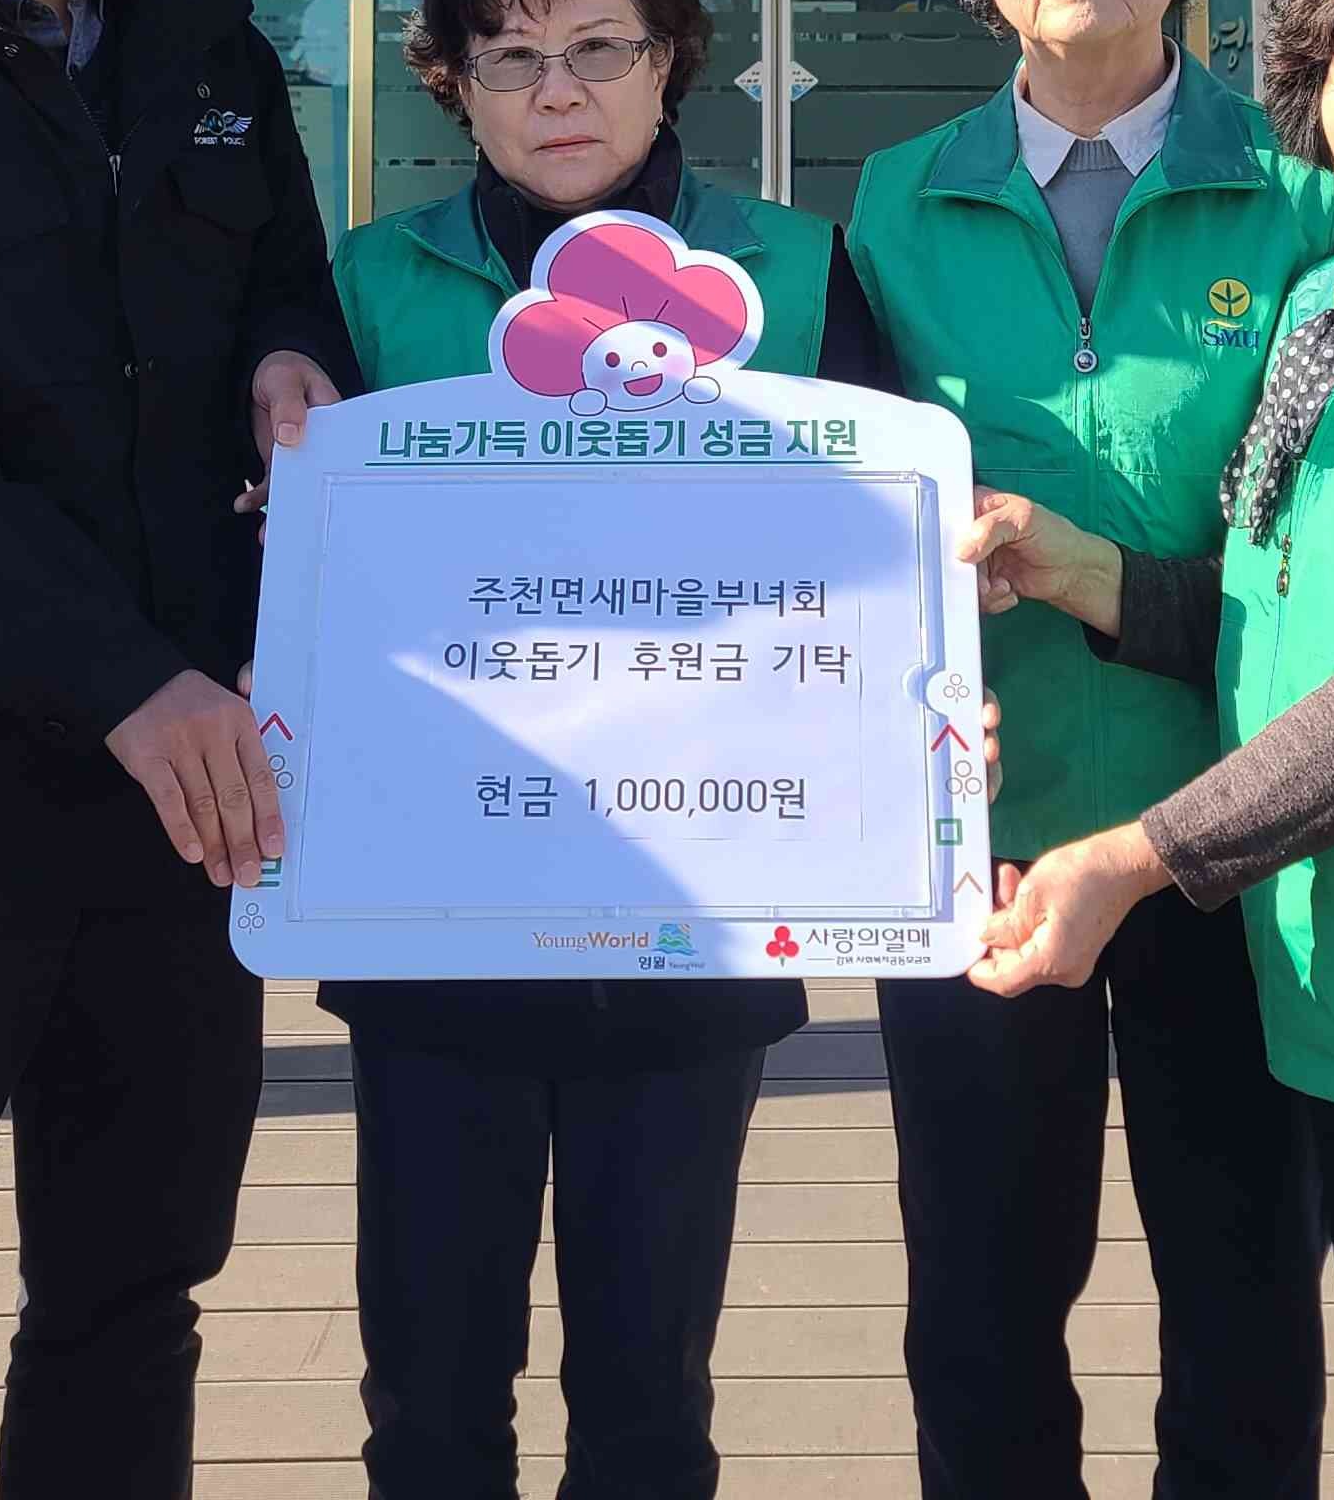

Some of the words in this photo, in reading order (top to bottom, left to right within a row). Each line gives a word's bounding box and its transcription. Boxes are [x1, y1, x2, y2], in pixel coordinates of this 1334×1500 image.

[378, 420, 527, 459] 나눔가득
[540, 419, 686, 457] 이웃돕기
[699, 419, 776, 457] 성금
[786, 418, 858, 456] 지원
[467, 576, 828, 619] 주천면새마을부녀회
[443, 640, 601, 683] 이웃돕기
[626, 640, 750, 683] 후원금
[773, 640, 852, 684] 기탁
[475, 775, 558, 818] 현금
[583, 775, 808, 819] 1,000,000원
[532, 931, 649, 952] YoungWorld
[806, 928, 931, 954] 사랑의열매
